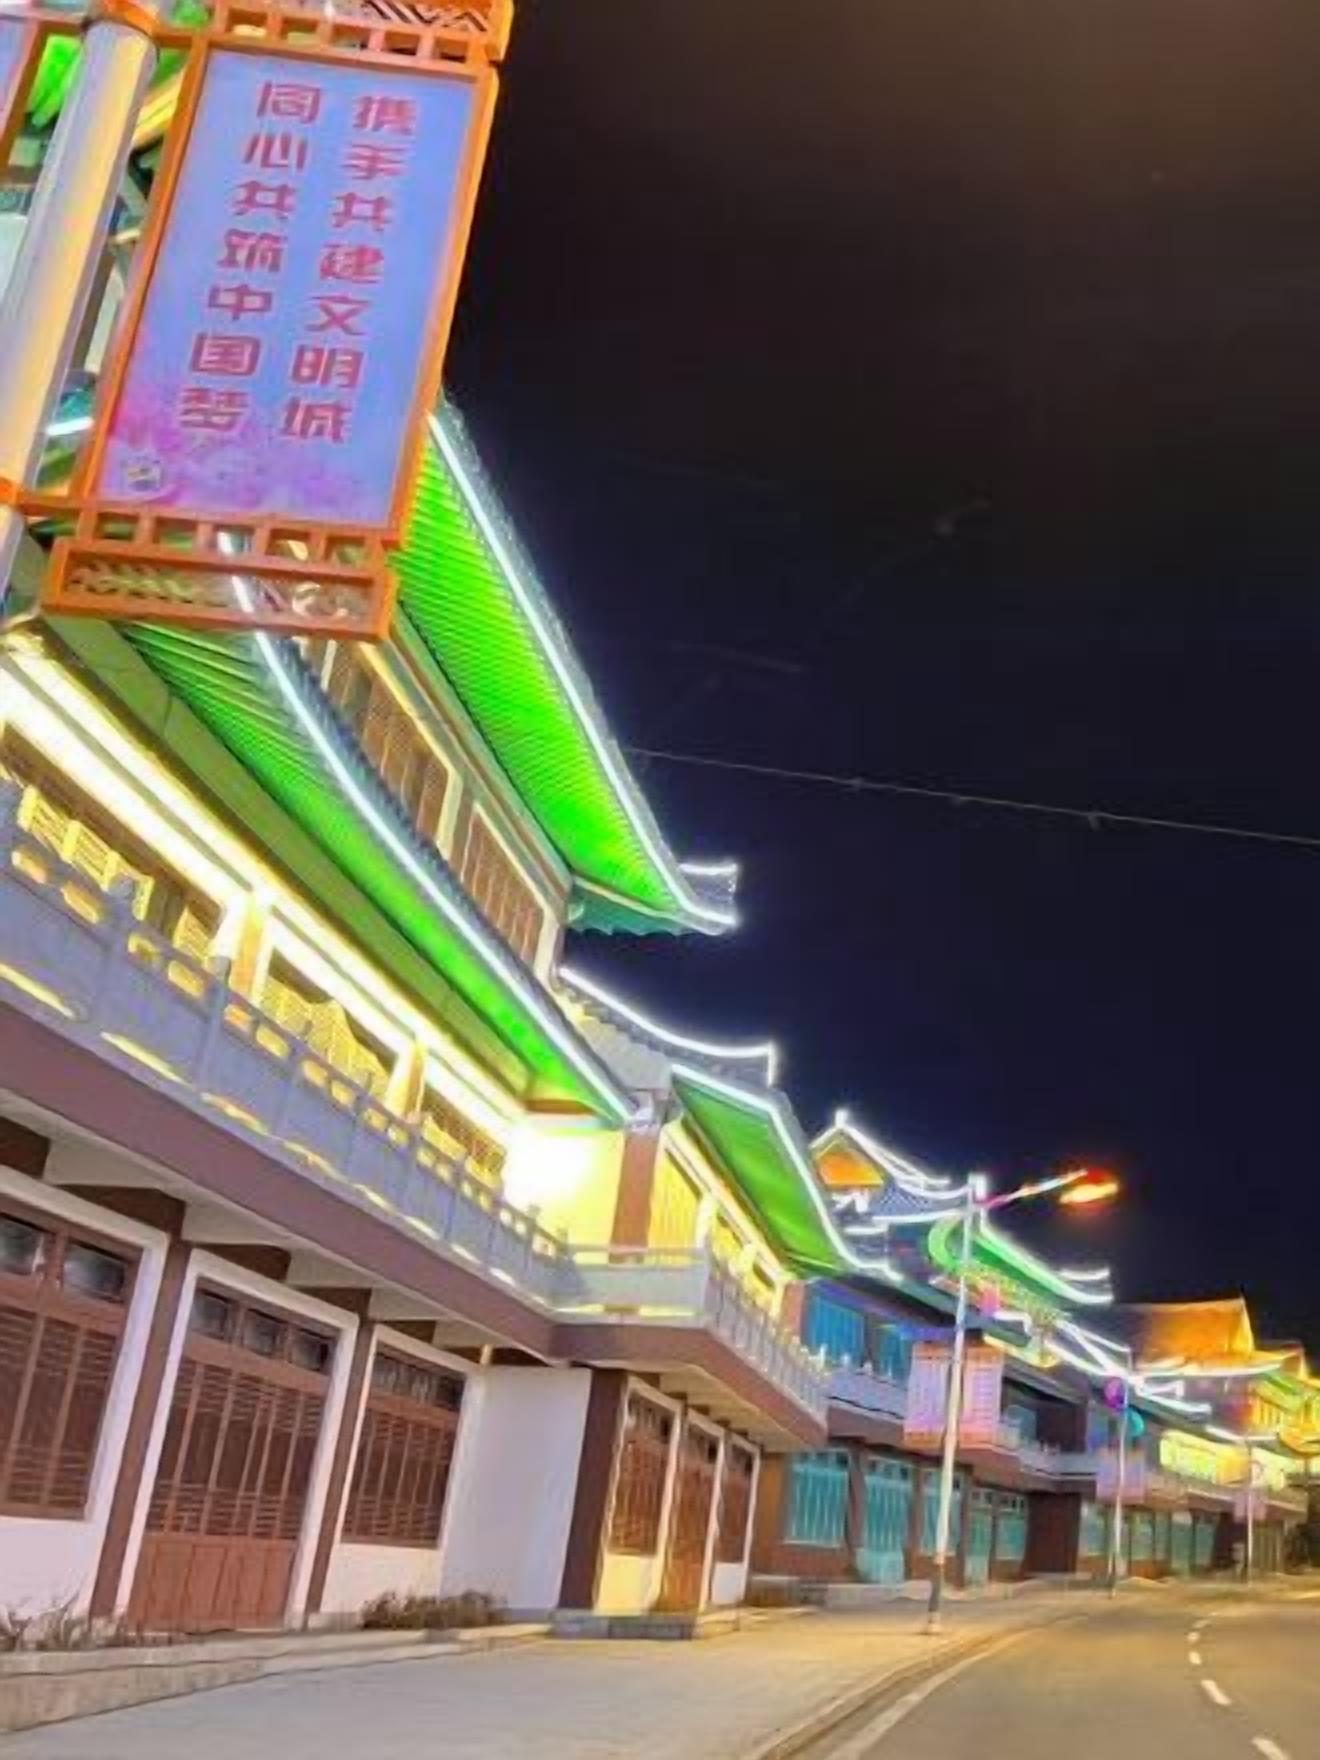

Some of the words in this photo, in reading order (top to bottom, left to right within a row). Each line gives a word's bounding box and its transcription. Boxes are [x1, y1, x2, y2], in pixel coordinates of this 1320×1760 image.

[178, 79, 322, 432] 同心共筑中国梦
[281, 95, 417, 443] 携手共建文明城
